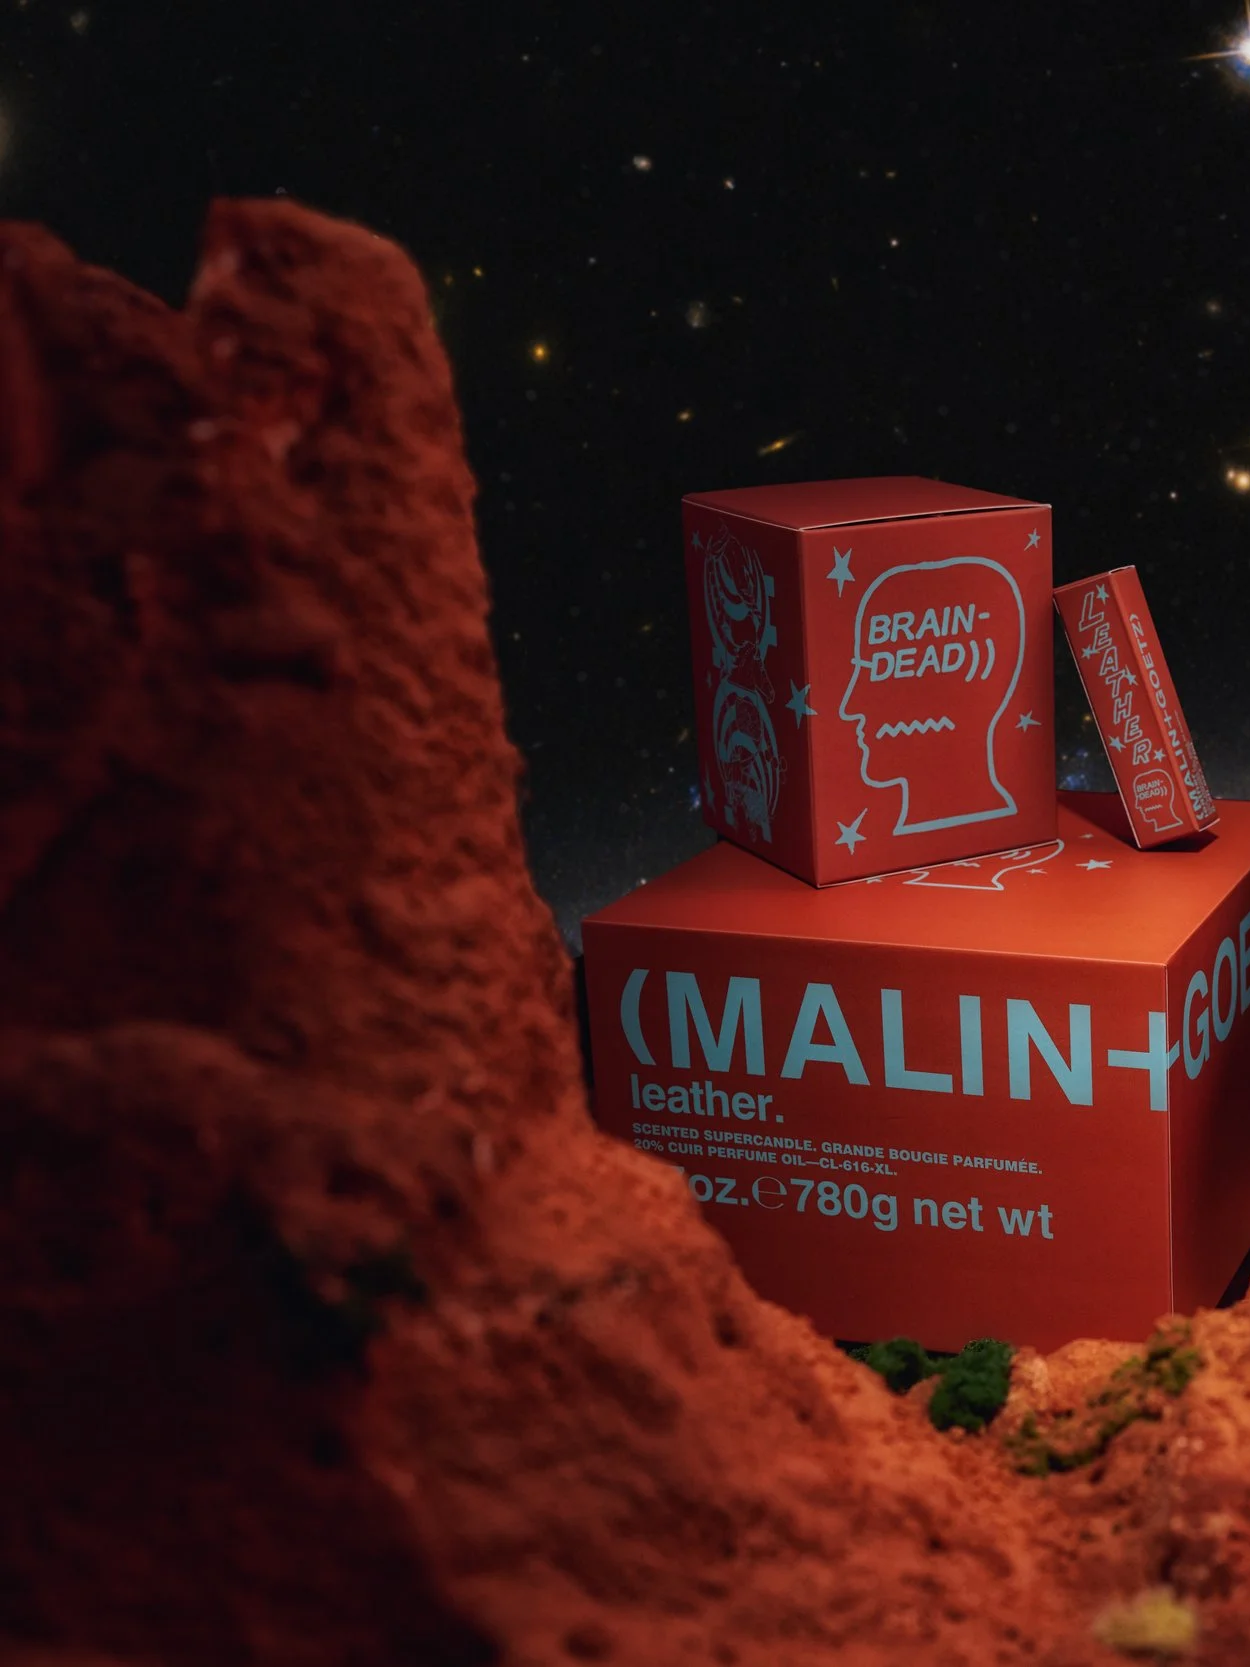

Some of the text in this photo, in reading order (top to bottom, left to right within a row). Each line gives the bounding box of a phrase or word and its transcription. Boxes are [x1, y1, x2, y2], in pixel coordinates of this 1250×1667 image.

[868, 603, 990, 645] BRAIN-
[1078, 591, 1153, 766] LEATHER
[630, 1073, 785, 1123] leather.
[632, 1122, 1043, 1174] SCENTED SUPERCANDLE. GRANDE BOUGIE PARFUMÉE.
[633, 1138, 664, 1151] 20%
[667, 1141, 703, 1156] CUIR
[707, 1145, 777, 1164] PERFUME
[913, 1197, 984, 1232] net
[997, 1204, 1054, 1240] wt
